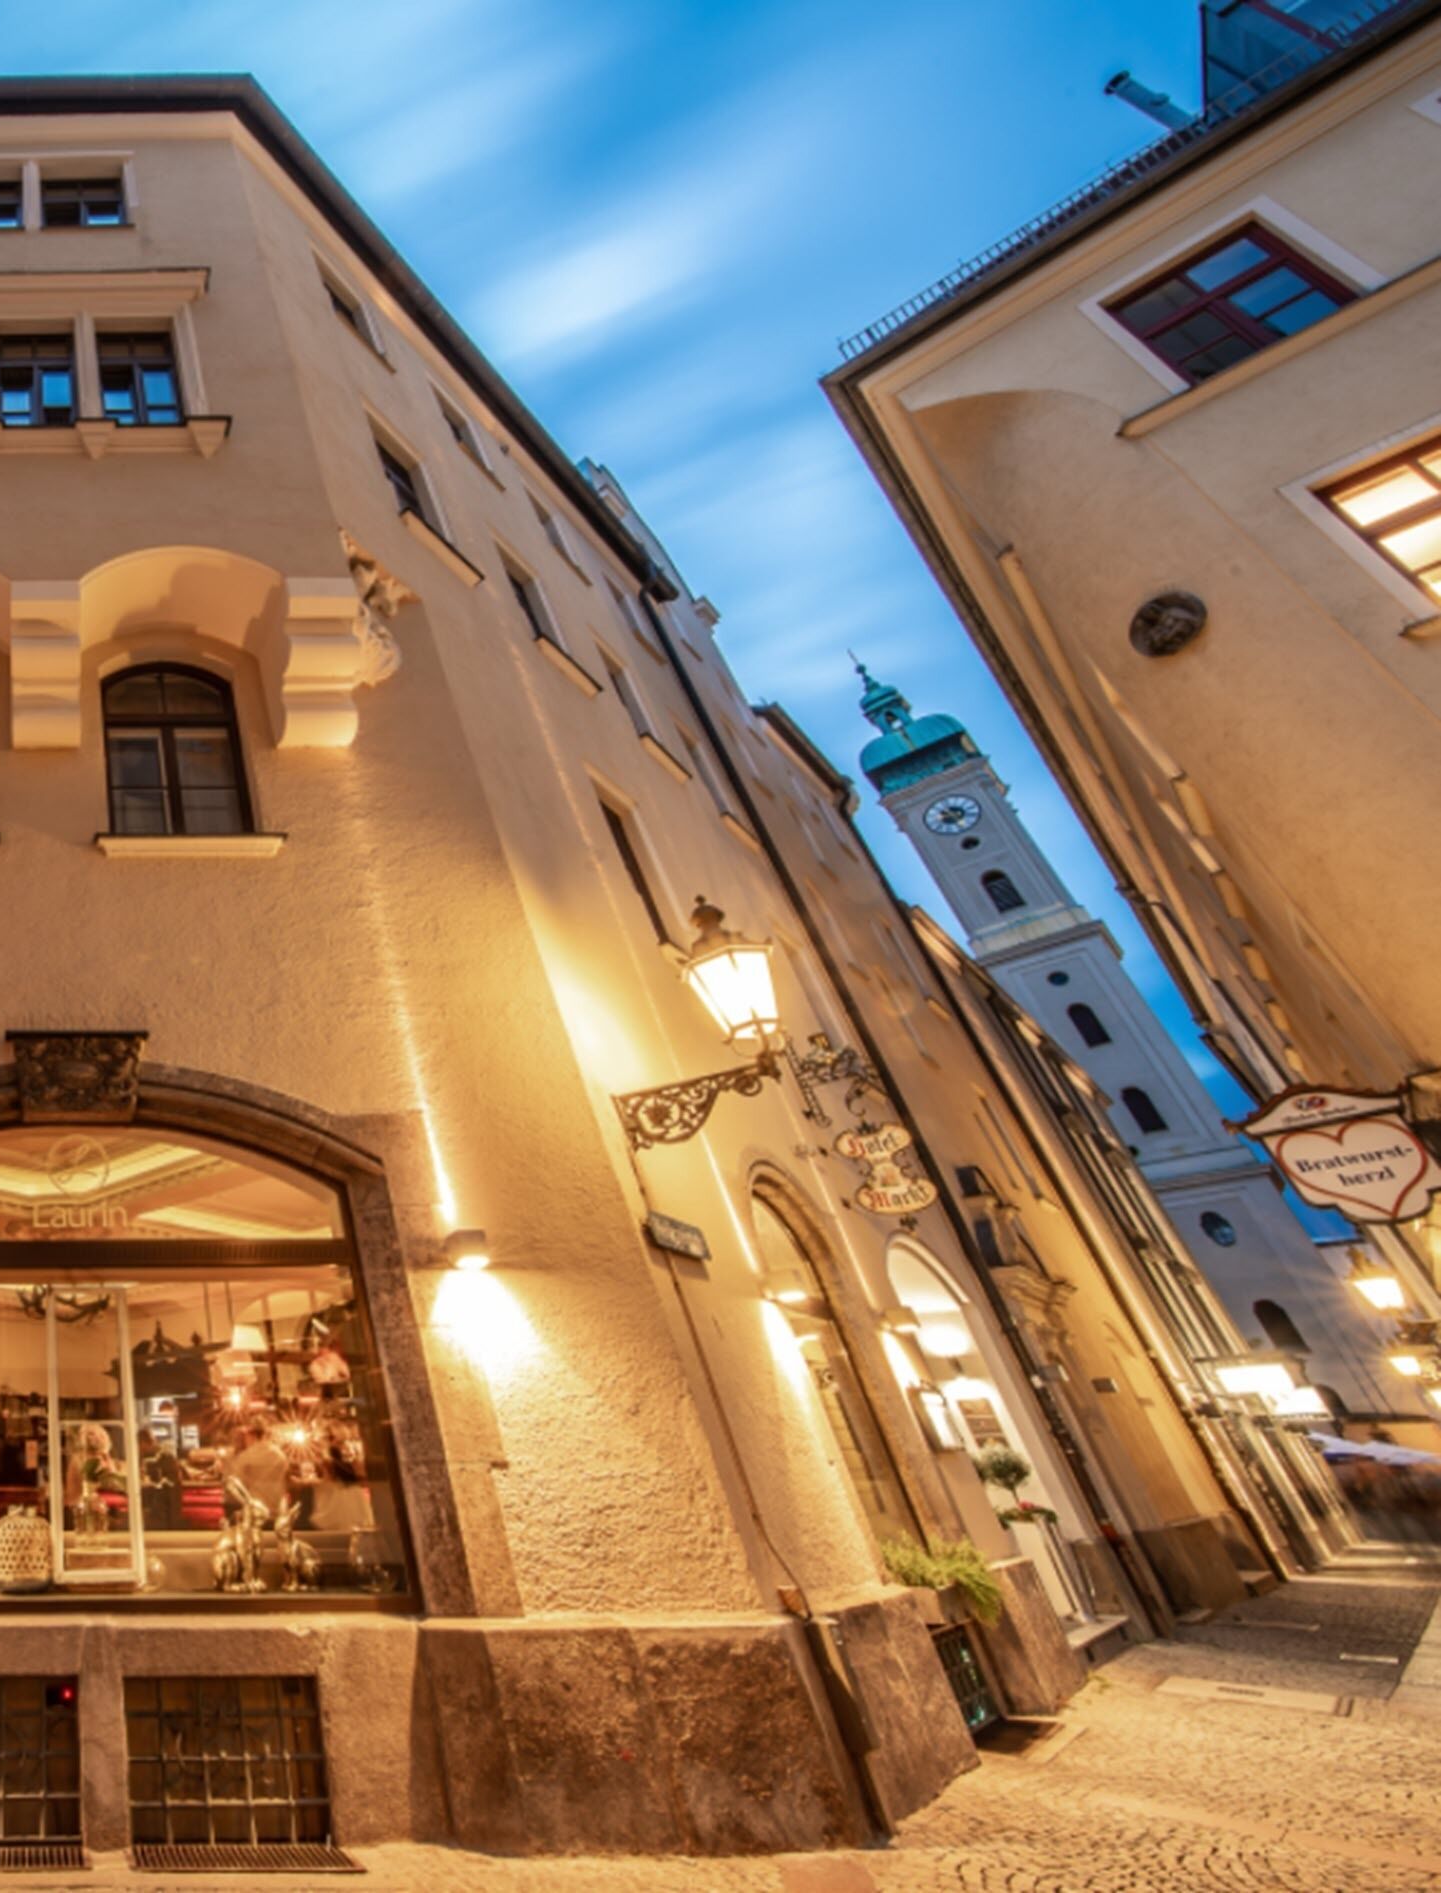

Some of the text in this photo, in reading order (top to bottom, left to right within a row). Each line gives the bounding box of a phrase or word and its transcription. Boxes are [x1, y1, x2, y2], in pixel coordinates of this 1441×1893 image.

[1295, 1145, 1414, 1173] Bratwurst-
[1337, 1165, 1396, 1188] herzl
[863, 1186, 930, 1210] Markt
[32, 1201, 128, 1229] Laurin
